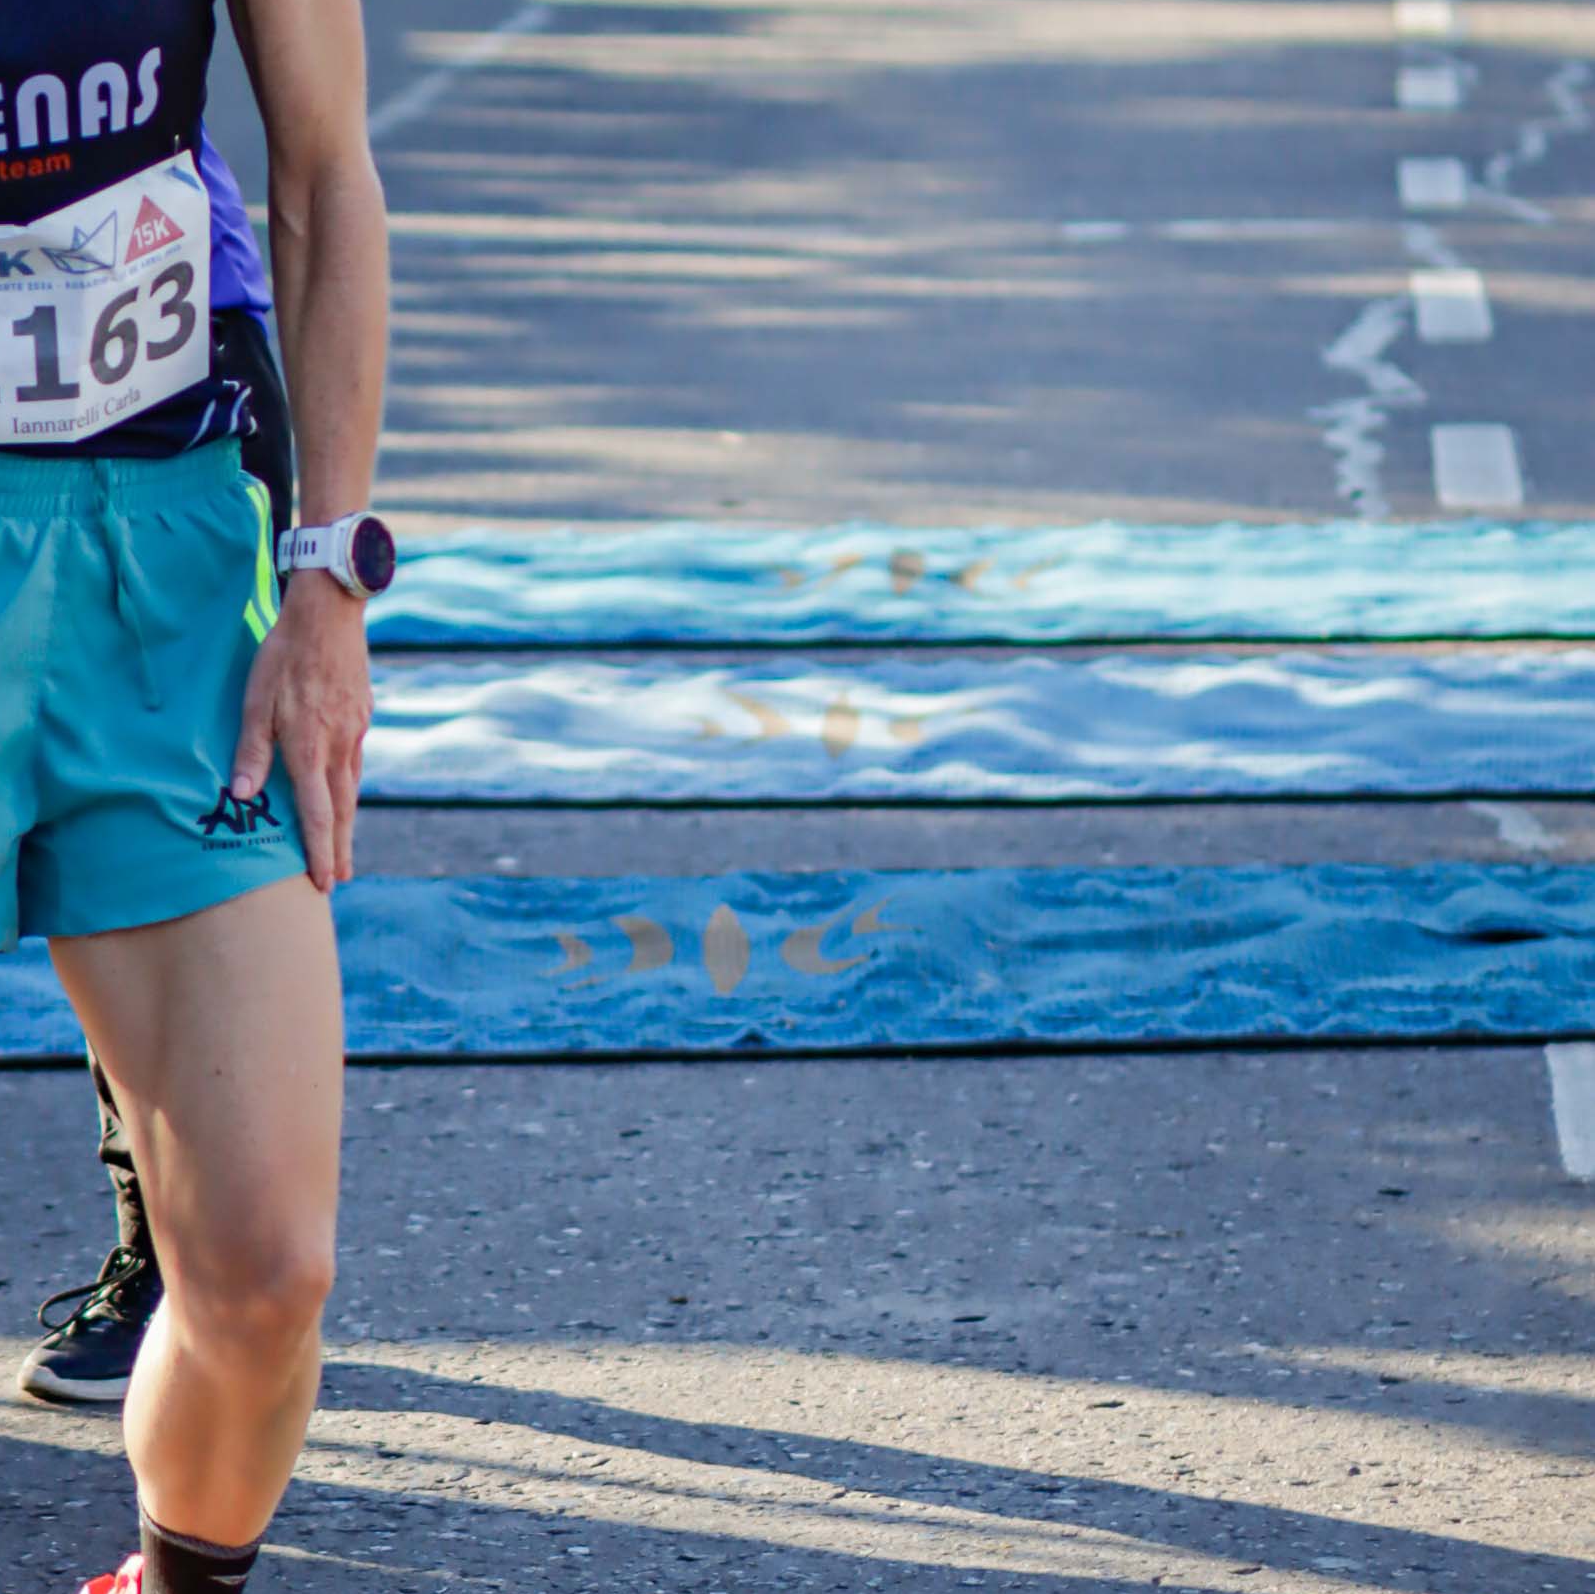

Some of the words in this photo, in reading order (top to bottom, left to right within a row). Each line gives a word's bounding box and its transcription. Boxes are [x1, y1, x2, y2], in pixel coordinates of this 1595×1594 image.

[133, 215, 171, 250] 15K
[12, 401, 100, 435] Iannarelli
[103, 386, 141, 416] Carla
